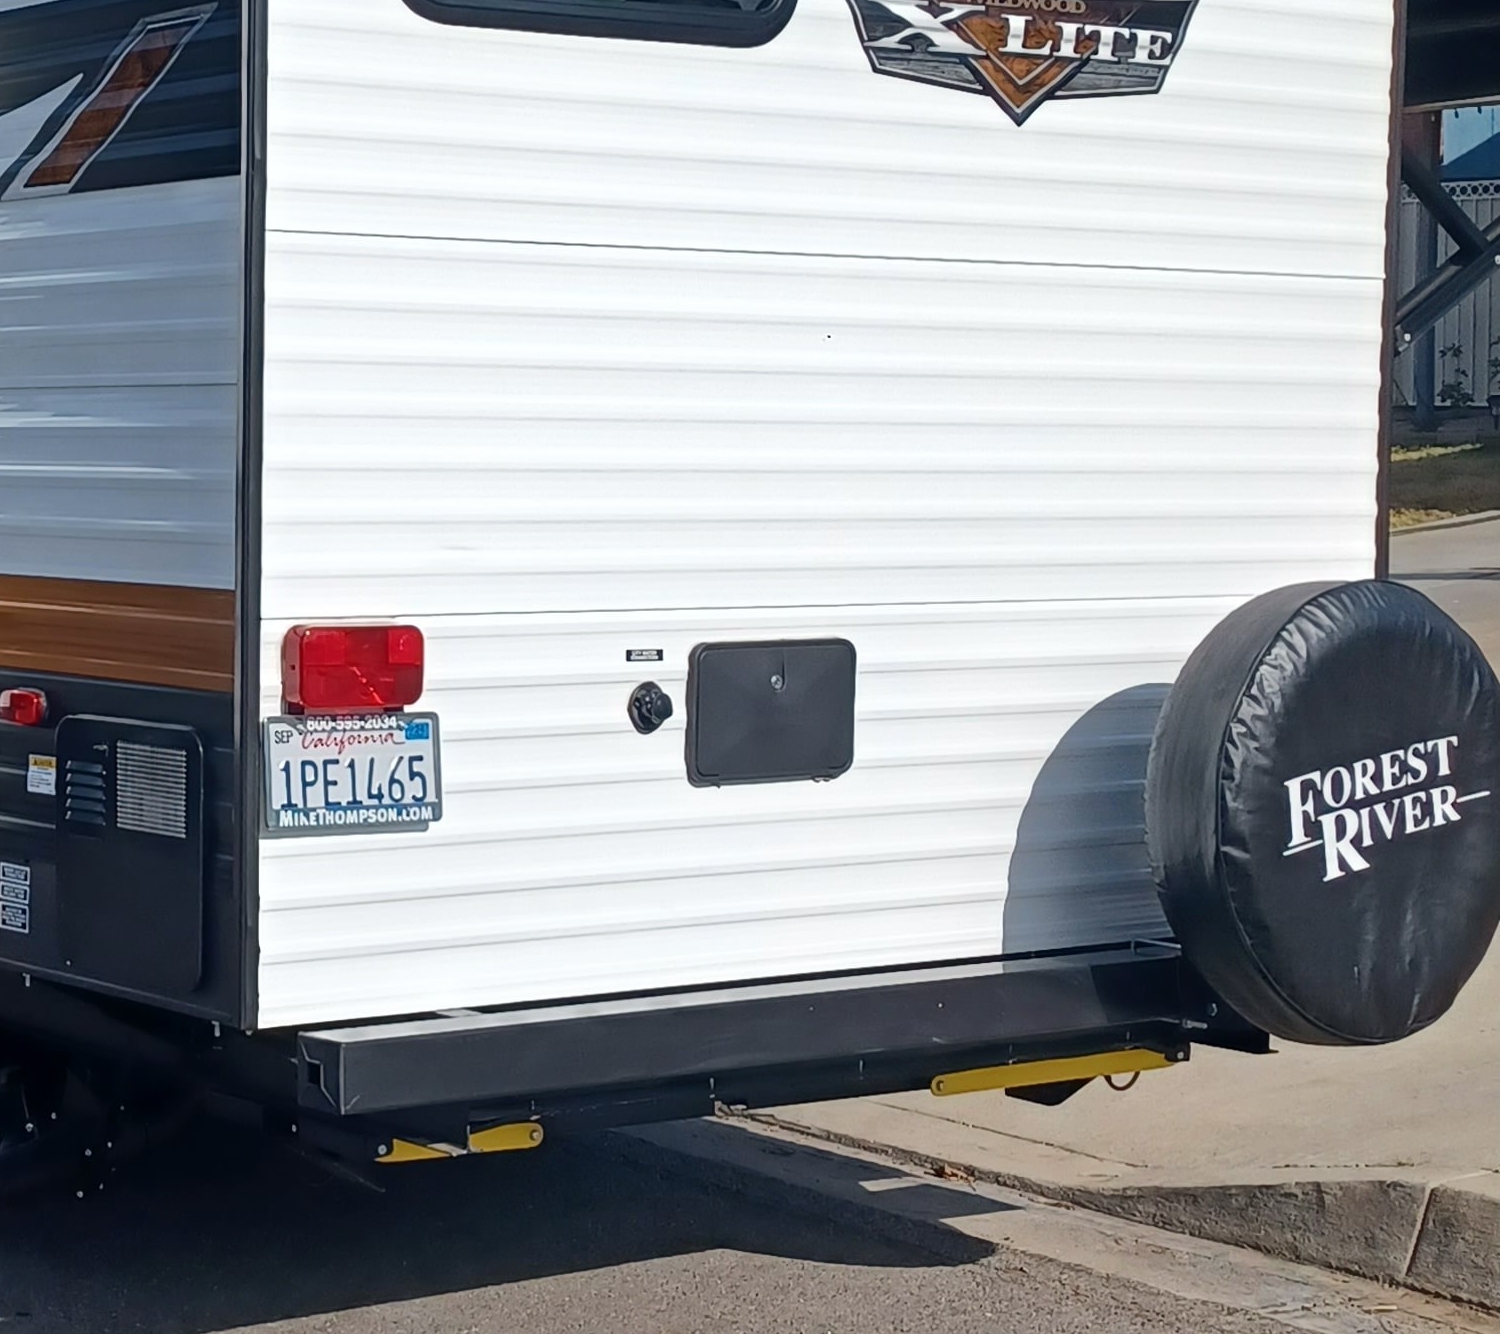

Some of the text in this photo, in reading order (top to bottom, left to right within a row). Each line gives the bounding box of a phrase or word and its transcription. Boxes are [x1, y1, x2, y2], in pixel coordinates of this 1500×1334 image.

[274, 730, 294, 744] SEP
[301, 731, 406, 755] California
[279, 755, 428, 809] 1PE1465
[1284, 735, 1459, 848] FOREST
[1317, 785, 1462, 883] RIVER
